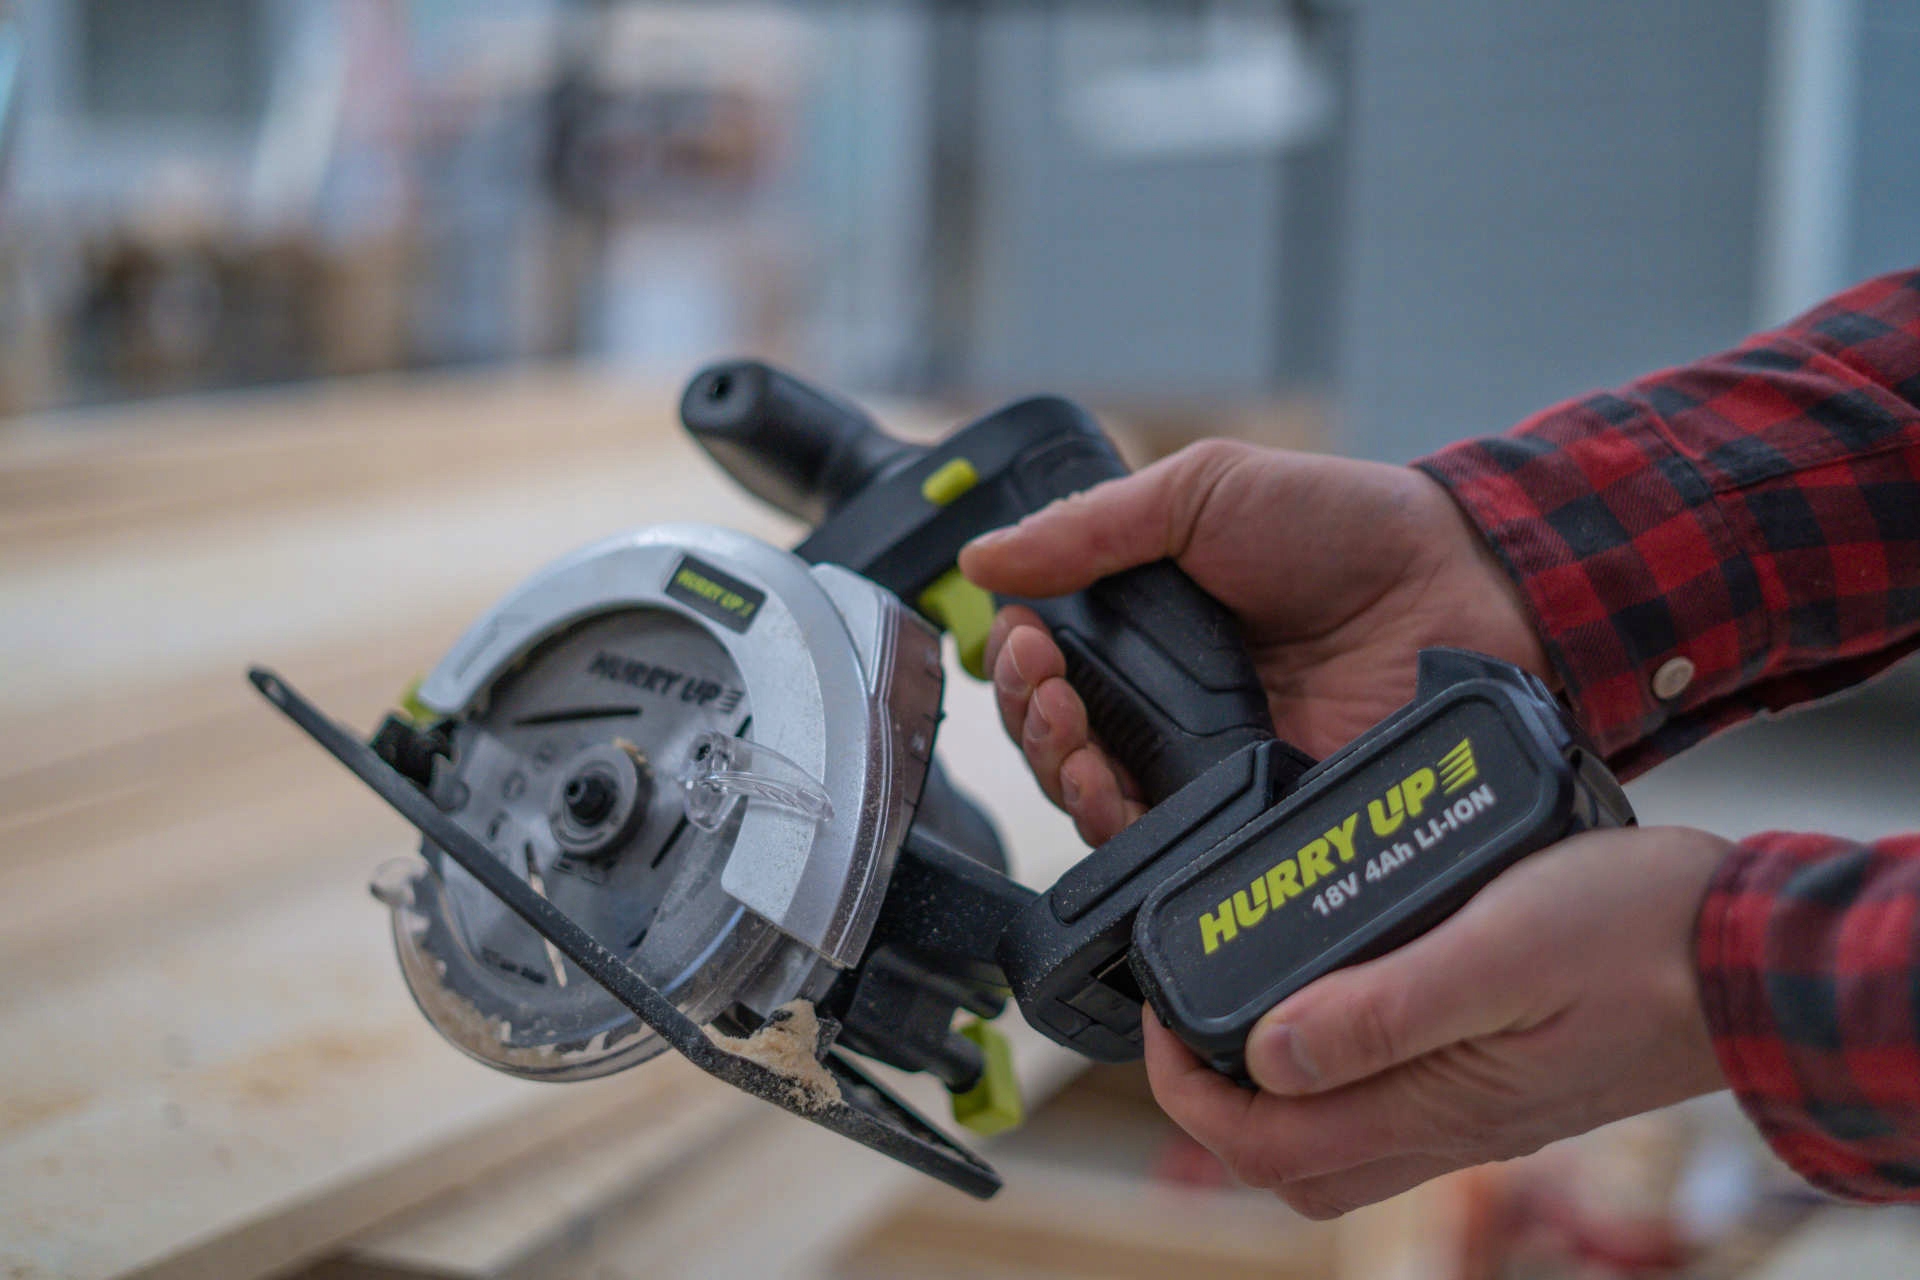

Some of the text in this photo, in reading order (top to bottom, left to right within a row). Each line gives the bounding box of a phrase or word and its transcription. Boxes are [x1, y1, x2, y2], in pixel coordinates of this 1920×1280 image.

[677, 569, 745, 611] HURRY UP
[589, 651, 722, 706] HURRY UP
[1199, 767, 1436, 955] HURRY UP
[1312, 783, 1496, 916] 18V 4Ah LI-ION
